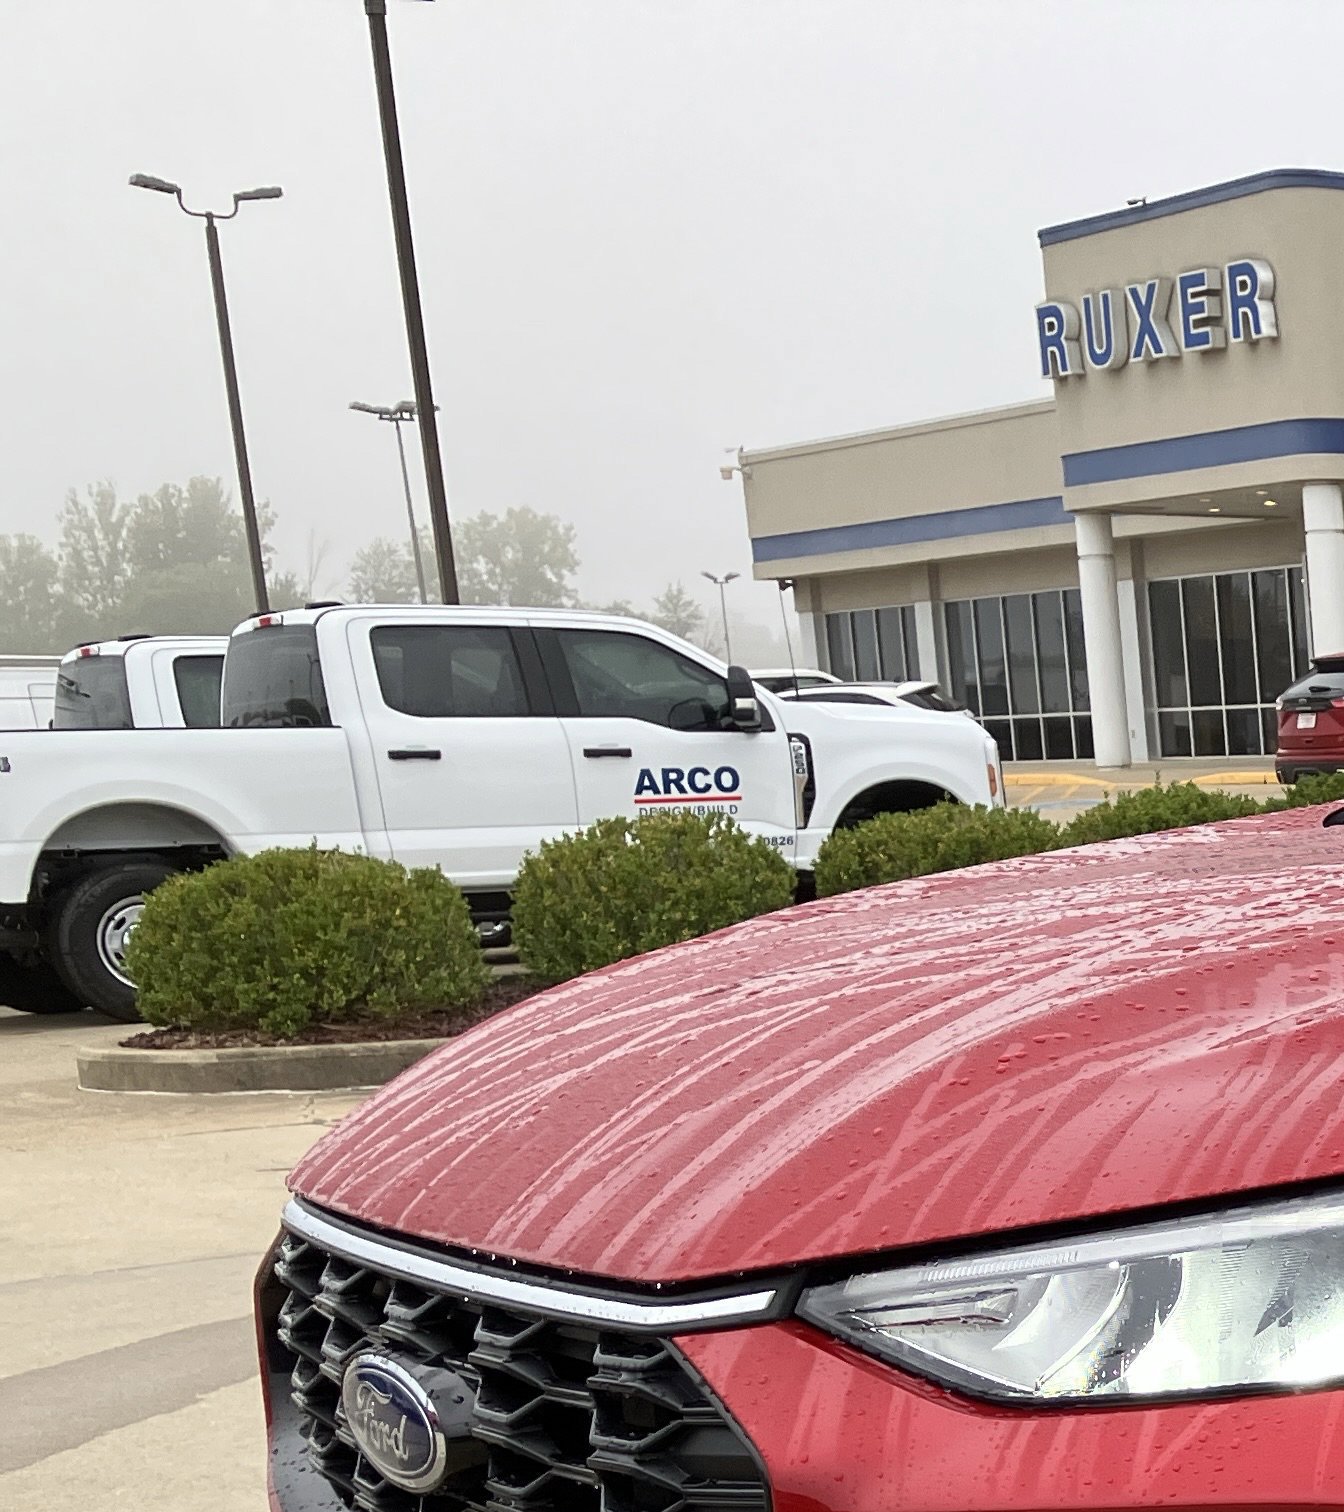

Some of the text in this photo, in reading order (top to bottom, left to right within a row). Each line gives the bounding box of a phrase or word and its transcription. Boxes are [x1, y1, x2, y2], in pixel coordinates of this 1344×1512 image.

[1035, 258, 1279, 379] RUXER
[634, 766, 740, 795] ARCO
[354, 1380, 409, 1461] Ford
